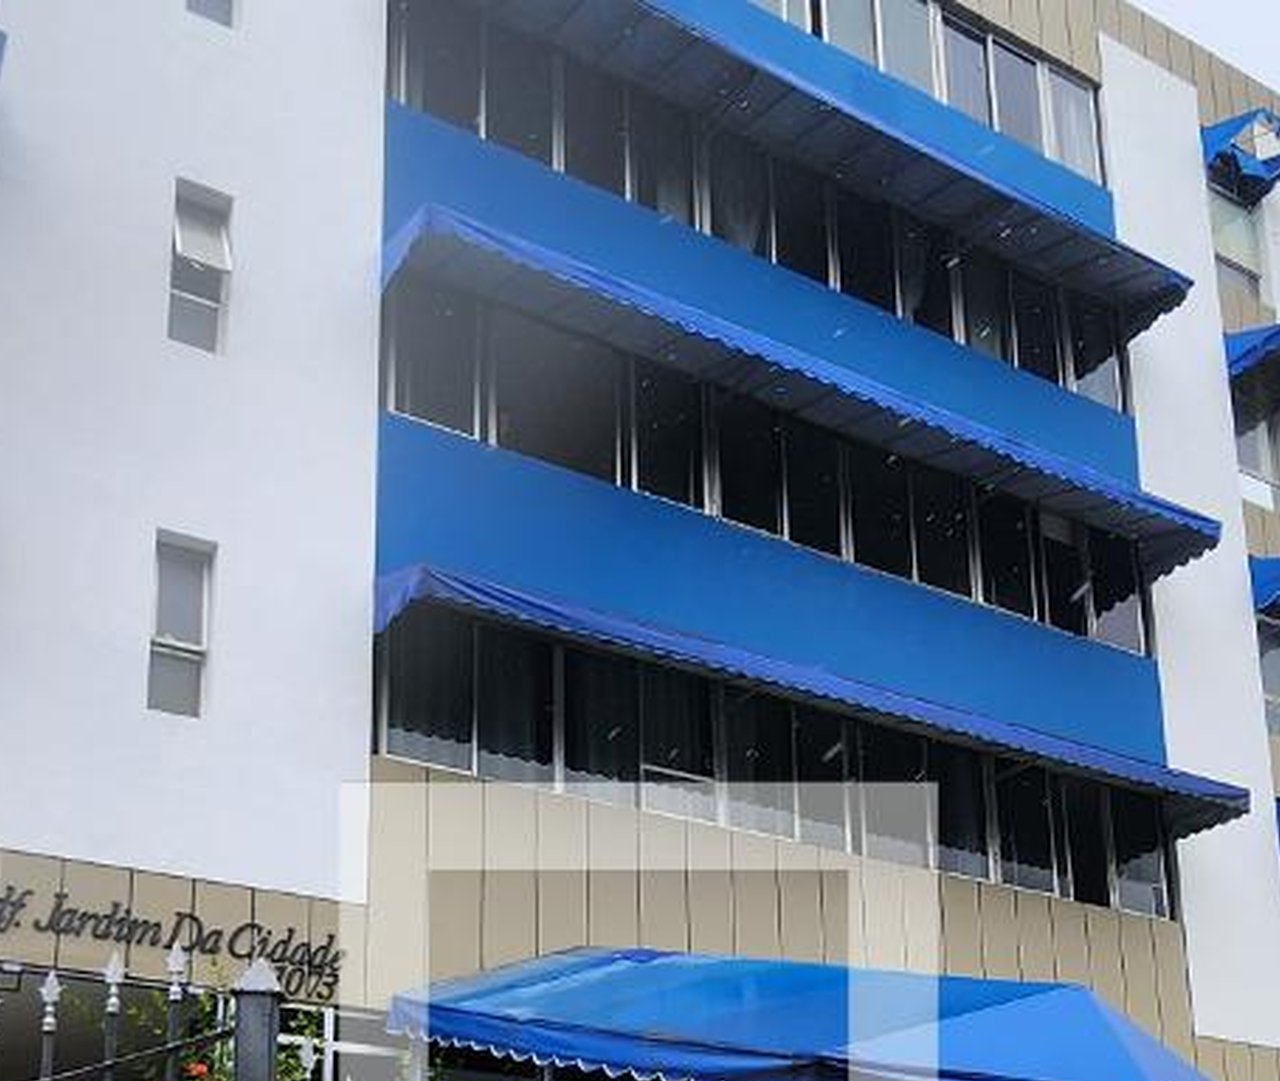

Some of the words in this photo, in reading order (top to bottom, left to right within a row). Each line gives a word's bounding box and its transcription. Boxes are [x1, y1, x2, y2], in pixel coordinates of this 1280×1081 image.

[33, 893, 163, 947] Jardim
[163, 911, 223, 955] Da
[227, 922, 346, 972] Cidade
